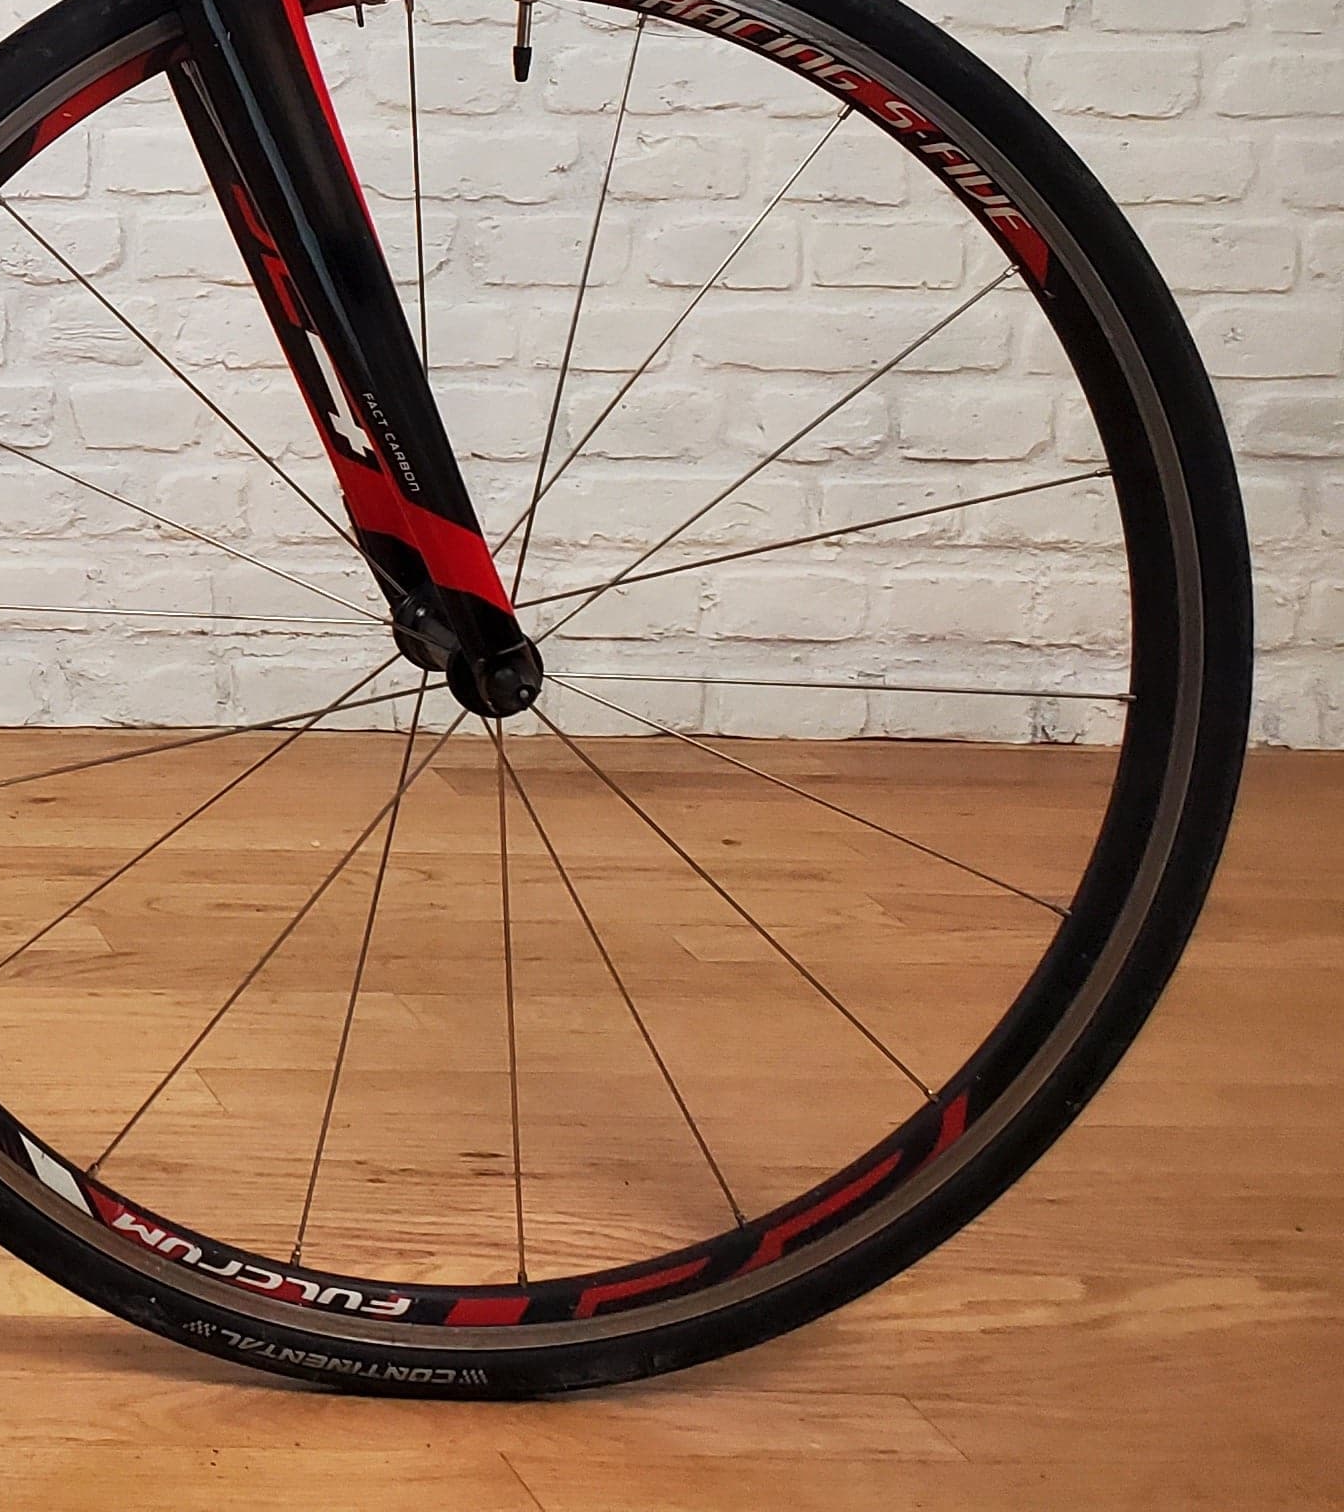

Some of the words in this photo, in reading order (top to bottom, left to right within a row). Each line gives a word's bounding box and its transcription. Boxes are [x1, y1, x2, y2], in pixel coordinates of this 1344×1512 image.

[362, 392, 389, 428] FACT
[385, 432, 422, 494] CARBON
[112, 1212, 413, 1318] FULCRUM
[220, 1326, 455, 1386] CONTINENTAL
